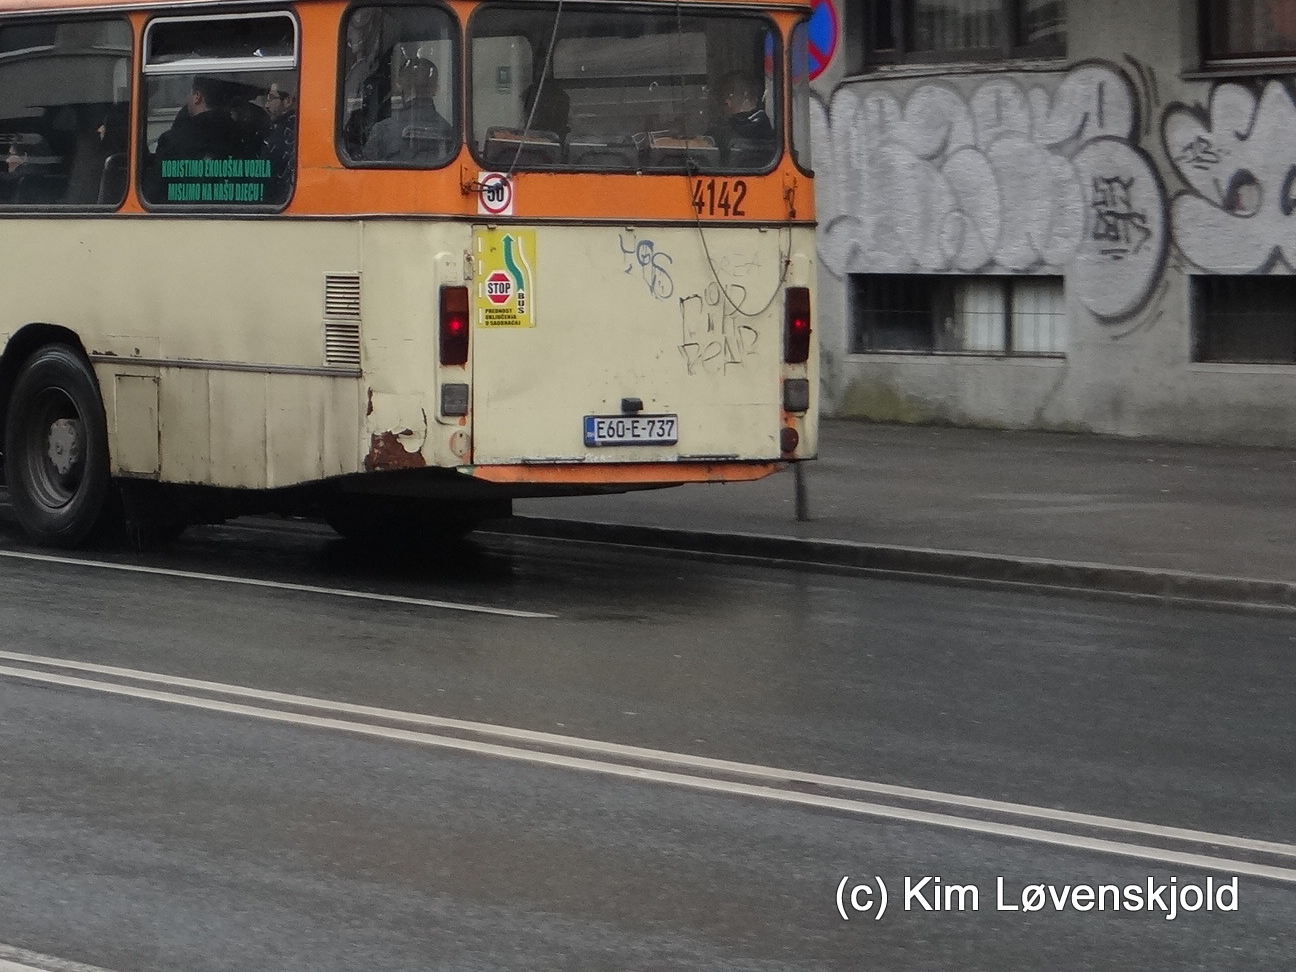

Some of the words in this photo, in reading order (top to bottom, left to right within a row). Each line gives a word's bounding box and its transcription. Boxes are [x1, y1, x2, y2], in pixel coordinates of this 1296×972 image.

[161, 159, 204, 178] KORISTIMO
[204, 156, 243, 178] EKOLOŠKA
[244, 159, 271, 178] VOZILA
[167, 182, 200, 201] MISLIMO
[202, 182, 212, 201] NA
[213, 179, 235, 201] NAŠU
[487, 184, 504, 203] 50
[691, 179, 747, 217] 4142
[487, 282, 511, 295] STOP
[517, 292, 525, 315] BUS
[596, 419, 675, 439] E60-E-737
